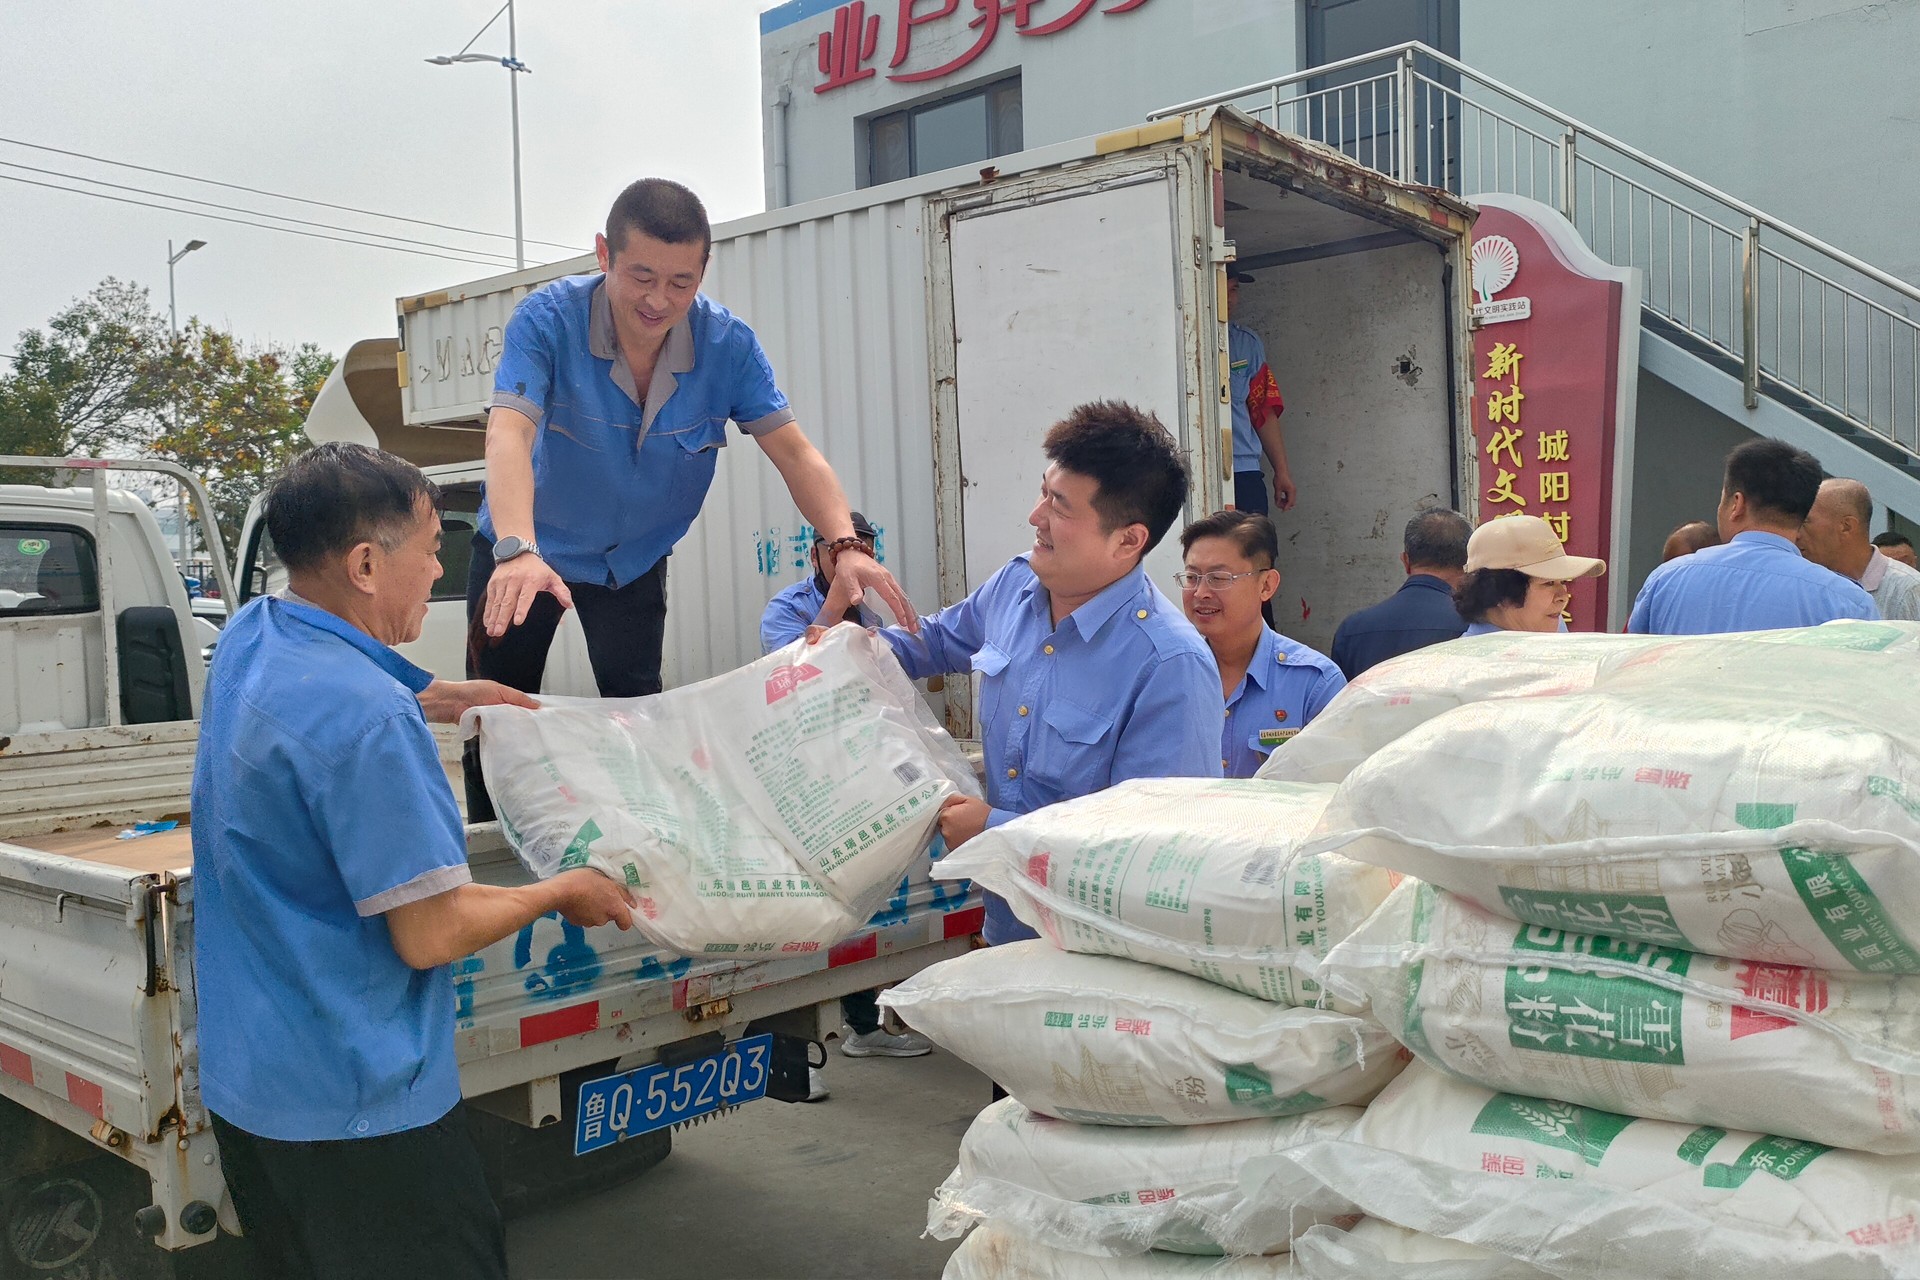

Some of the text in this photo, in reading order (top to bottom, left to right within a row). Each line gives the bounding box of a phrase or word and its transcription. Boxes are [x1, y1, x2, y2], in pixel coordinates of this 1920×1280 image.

[1482, 342, 1527, 519] 新时代文
[1508, 994, 1677, 1056] 雪花粉
[582, 1044, 767, 1142] 鲁Q·552Q3
